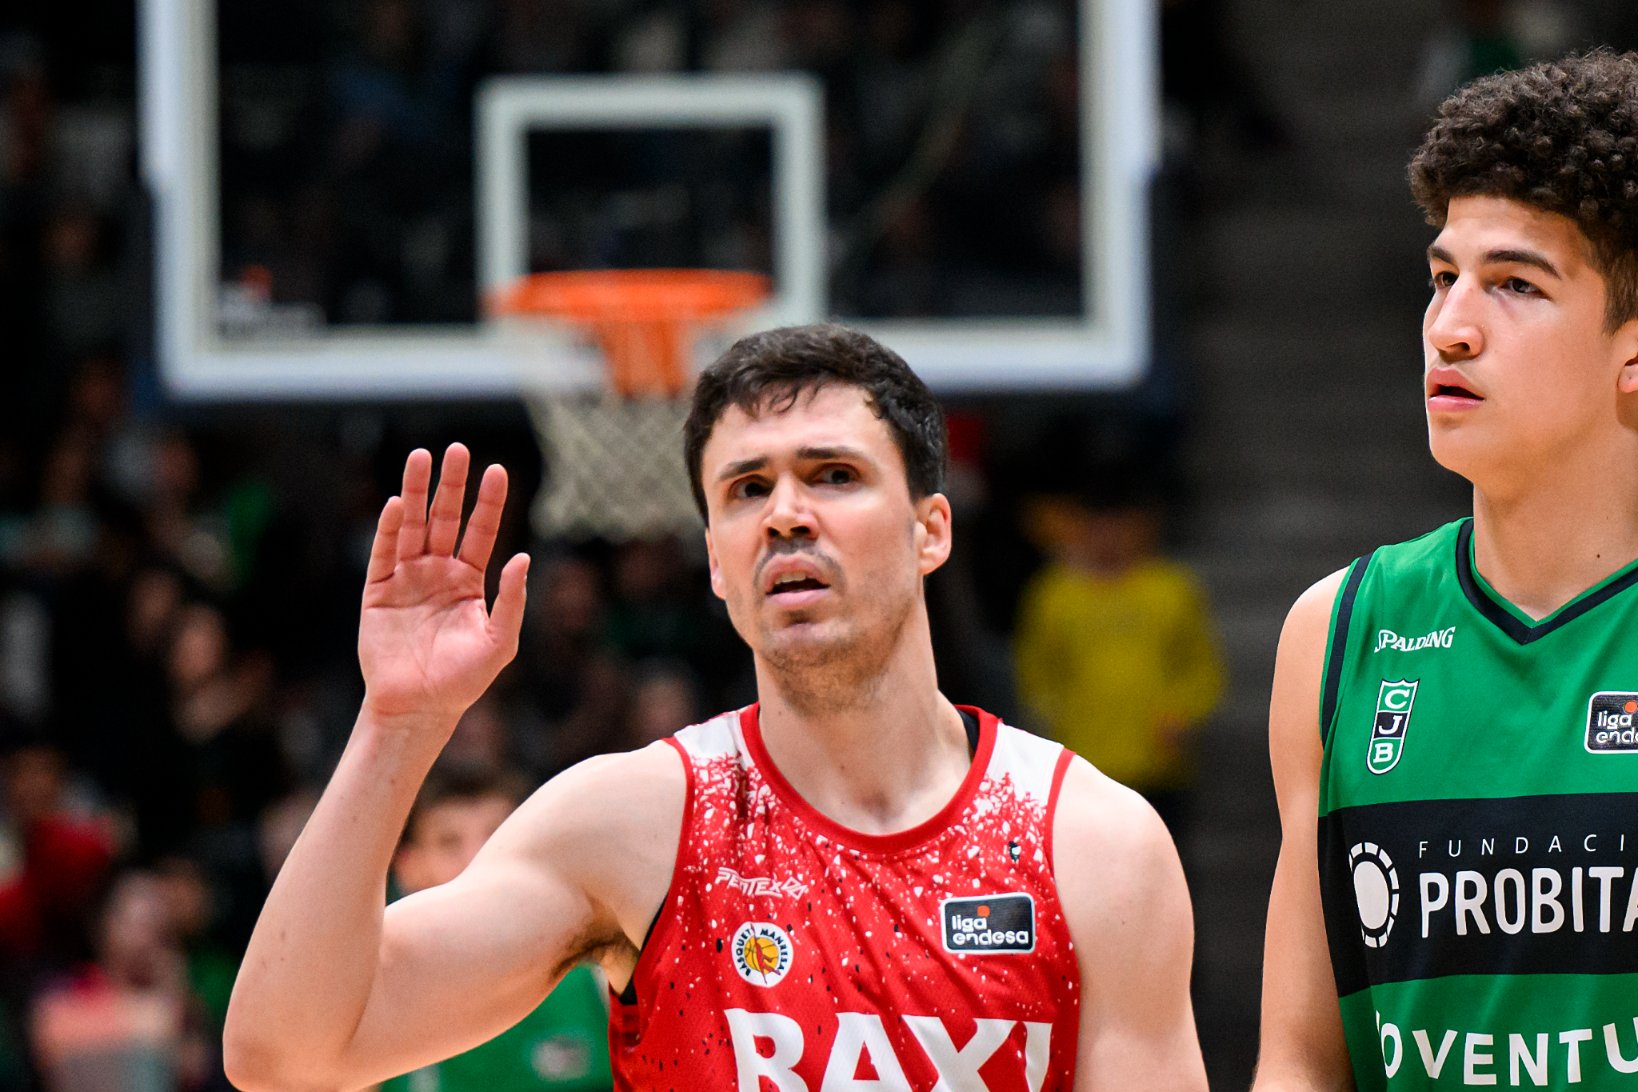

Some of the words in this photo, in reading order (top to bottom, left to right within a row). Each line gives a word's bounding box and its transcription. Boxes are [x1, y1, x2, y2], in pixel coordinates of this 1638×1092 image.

[1374, 626, 1456, 653] SPALDING
[1597, 710, 1632, 729] liga
[952, 915, 987, 932] liga
[953, 929, 1029, 945] endesa
